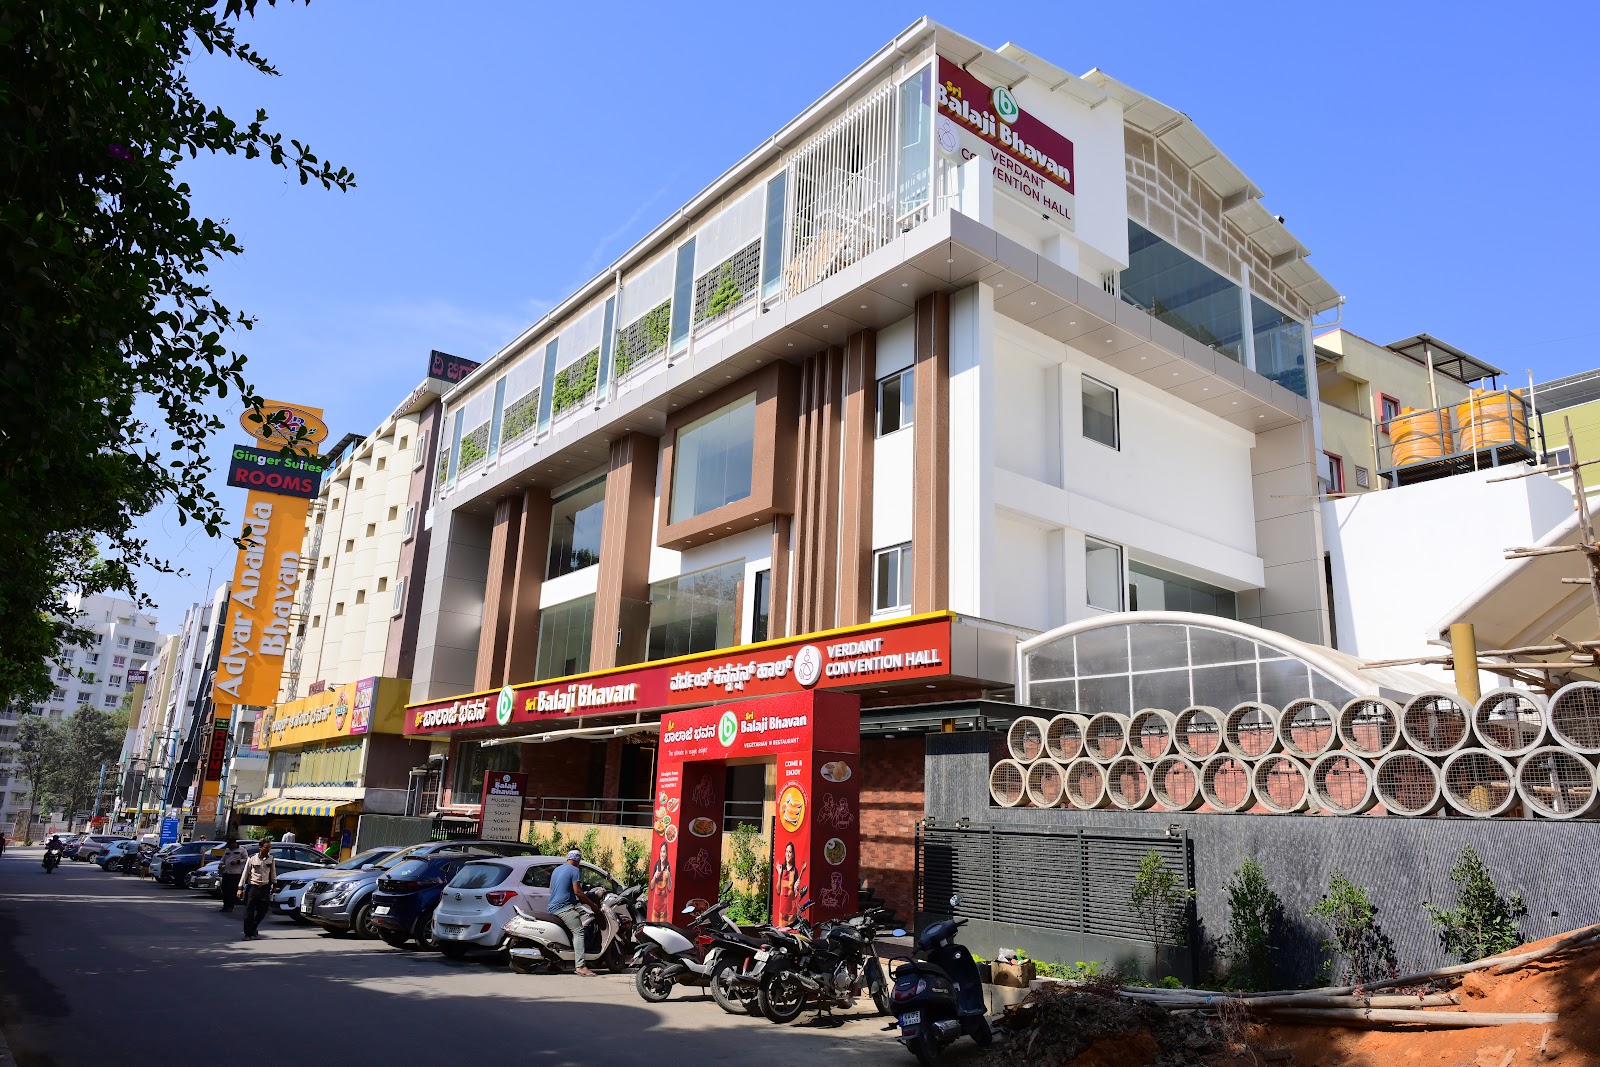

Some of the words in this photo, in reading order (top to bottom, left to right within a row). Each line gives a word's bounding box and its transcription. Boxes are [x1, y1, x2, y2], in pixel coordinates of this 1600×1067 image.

[946, 81, 962, 99] Sri
[938, 83, 996, 138] Balaji
[1000, 122, 1071, 185] Bhavan
[990, 148, 1046, 189] VERDANT
[1043, 195, 1072, 220] HALL
[233, 449, 281, 466] Ginger
[284, 458, 323, 473] Suites
[235, 467, 313, 493] ROOMS
[231, 501, 273, 610] Ananda
[259, 551, 300, 657] Bhavan
[216, 610, 254, 698] Adyar
[826, 638, 884, 659] VERDANT
[756, 655, 794, 680] ಹಾಲ್
[825, 653, 904, 677] CONVENTION
[905, 648, 942, 666] HALL
[525, 697, 538, 711] Sri
[537, 684, 579, 713] Balaji
[578, 683, 638, 706] Bhavan
[422, 701, 459, 727] ಬಾಲಾಜಿ
[459, 697, 488, 726] ಭವನ
[740, 716, 769, 733] Balaji
[769, 714, 807, 730] Bhavan
[745, 711, 754, 720] Sri
[664, 727, 693, 743] ಬಾಲಾಜಿ
[693, 723, 716, 741] ಭವನ
[495, 782, 517, 790] Balaji
